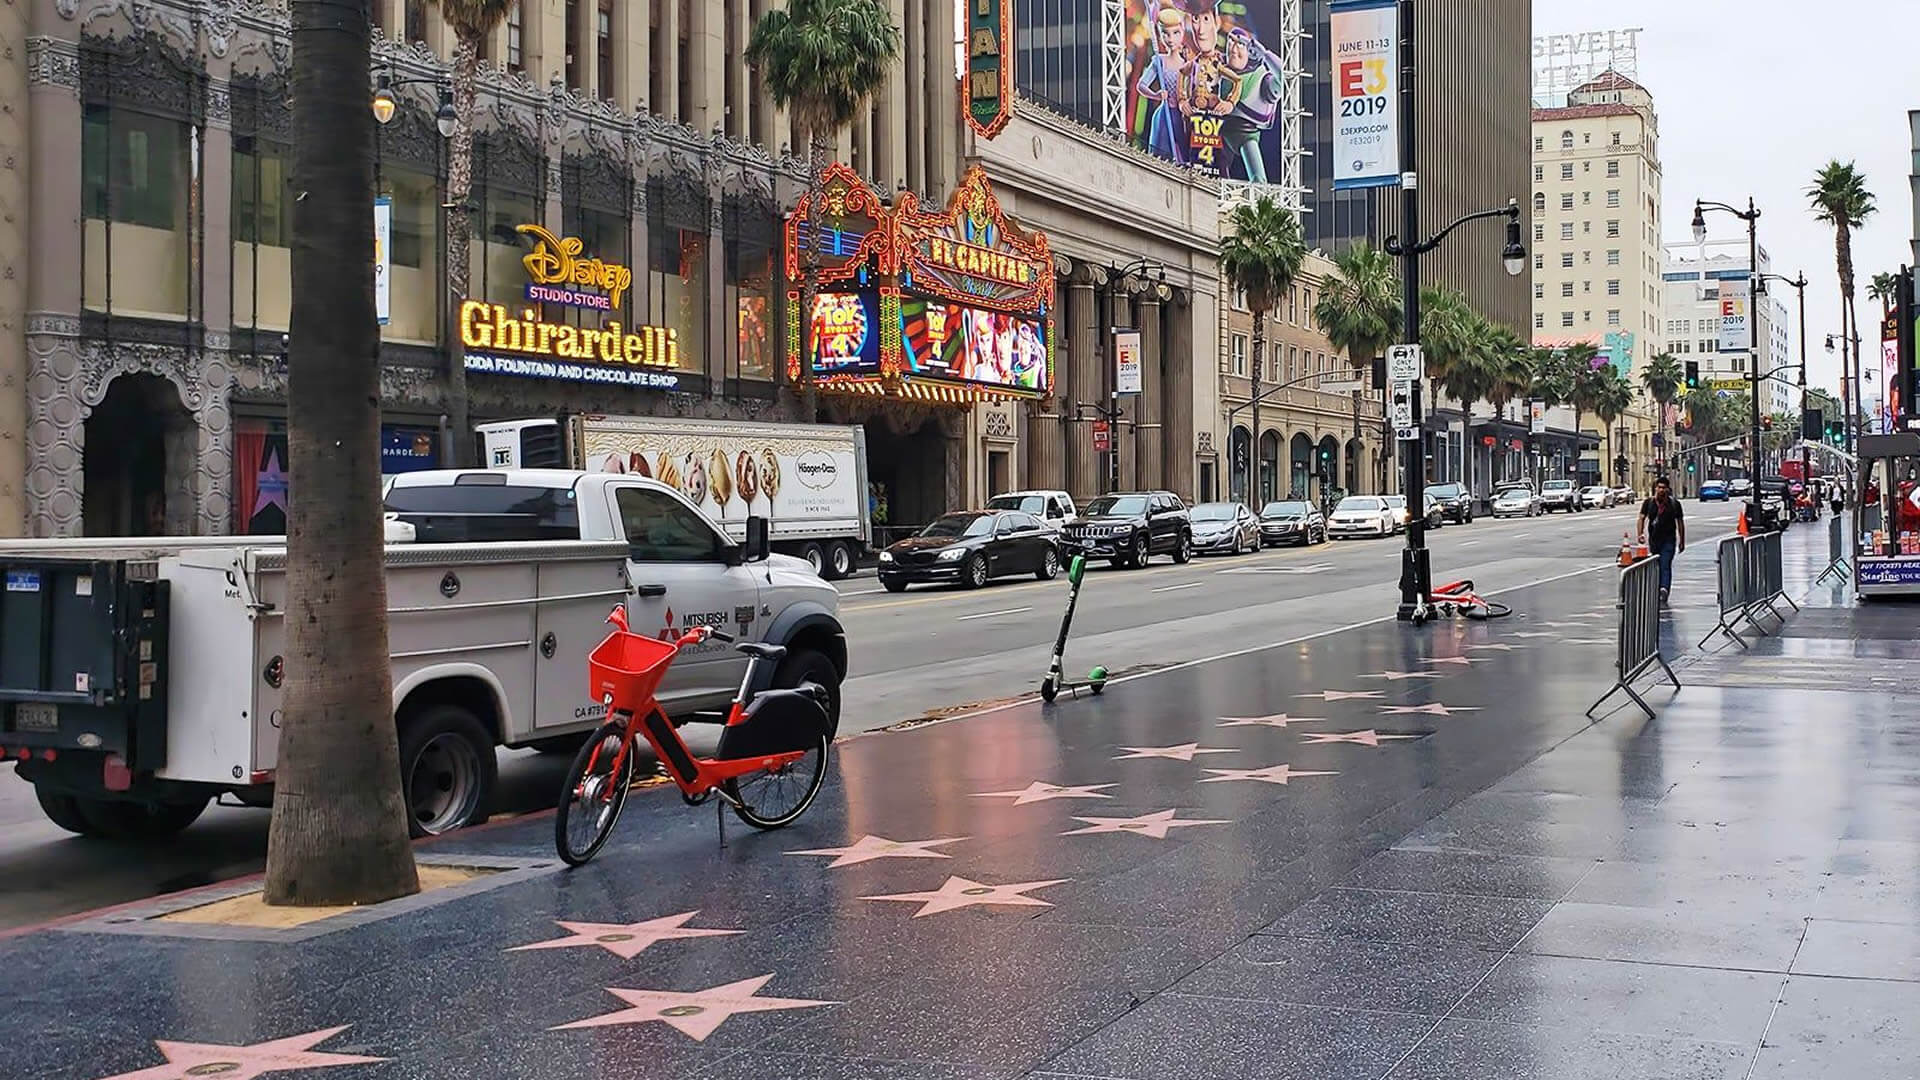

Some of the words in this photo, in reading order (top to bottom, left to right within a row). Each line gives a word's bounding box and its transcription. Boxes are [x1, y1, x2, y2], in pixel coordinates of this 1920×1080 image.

[1338, 41, 1362, 53] JUNE
[1366, 38, 1390, 49] 11-13
[1533, 27, 1643, 57] SEVELT
[1340, 59, 1388, 98] E3
[1341, 96, 1387, 117] 2019
[1190, 116, 1224, 136] TOY
[1340, 124, 1389, 136] E3EXPO.COM
[1193, 135, 1220, 145] STORY
[1350, 135, 1381, 146] #E32019
[1198, 145, 1215, 165] 4
[515, 223, 632, 309] Disney
[931, 238, 954, 264] EL
[956, 244, 1029, 283] CAPITAN
[529, 285, 574, 304] STUDIO
[574, 289, 611, 309] STORE
[824, 305, 858, 325] TOY
[1722, 300, 1745, 316] E3
[1722, 316, 1745, 325] 2019
[461, 300, 680, 368] Ghirardelli
[831, 334, 846, 353] 4
[463, 354, 494, 370] SODA
[496, 358, 556, 377] FOUNTAIN
[557, 364, 583, 379] AND
[583, 366, 649, 386] CHOCOLATE
[649, 374, 679, 387] SHOP
[1120, 363, 1138, 372] 2019
[383, 447, 430, 457] RARDE
[1860, 571, 1901, 583] Starline
[683, 611, 728, 627] MITSUBISHI
[575, 707, 587, 718] CA
